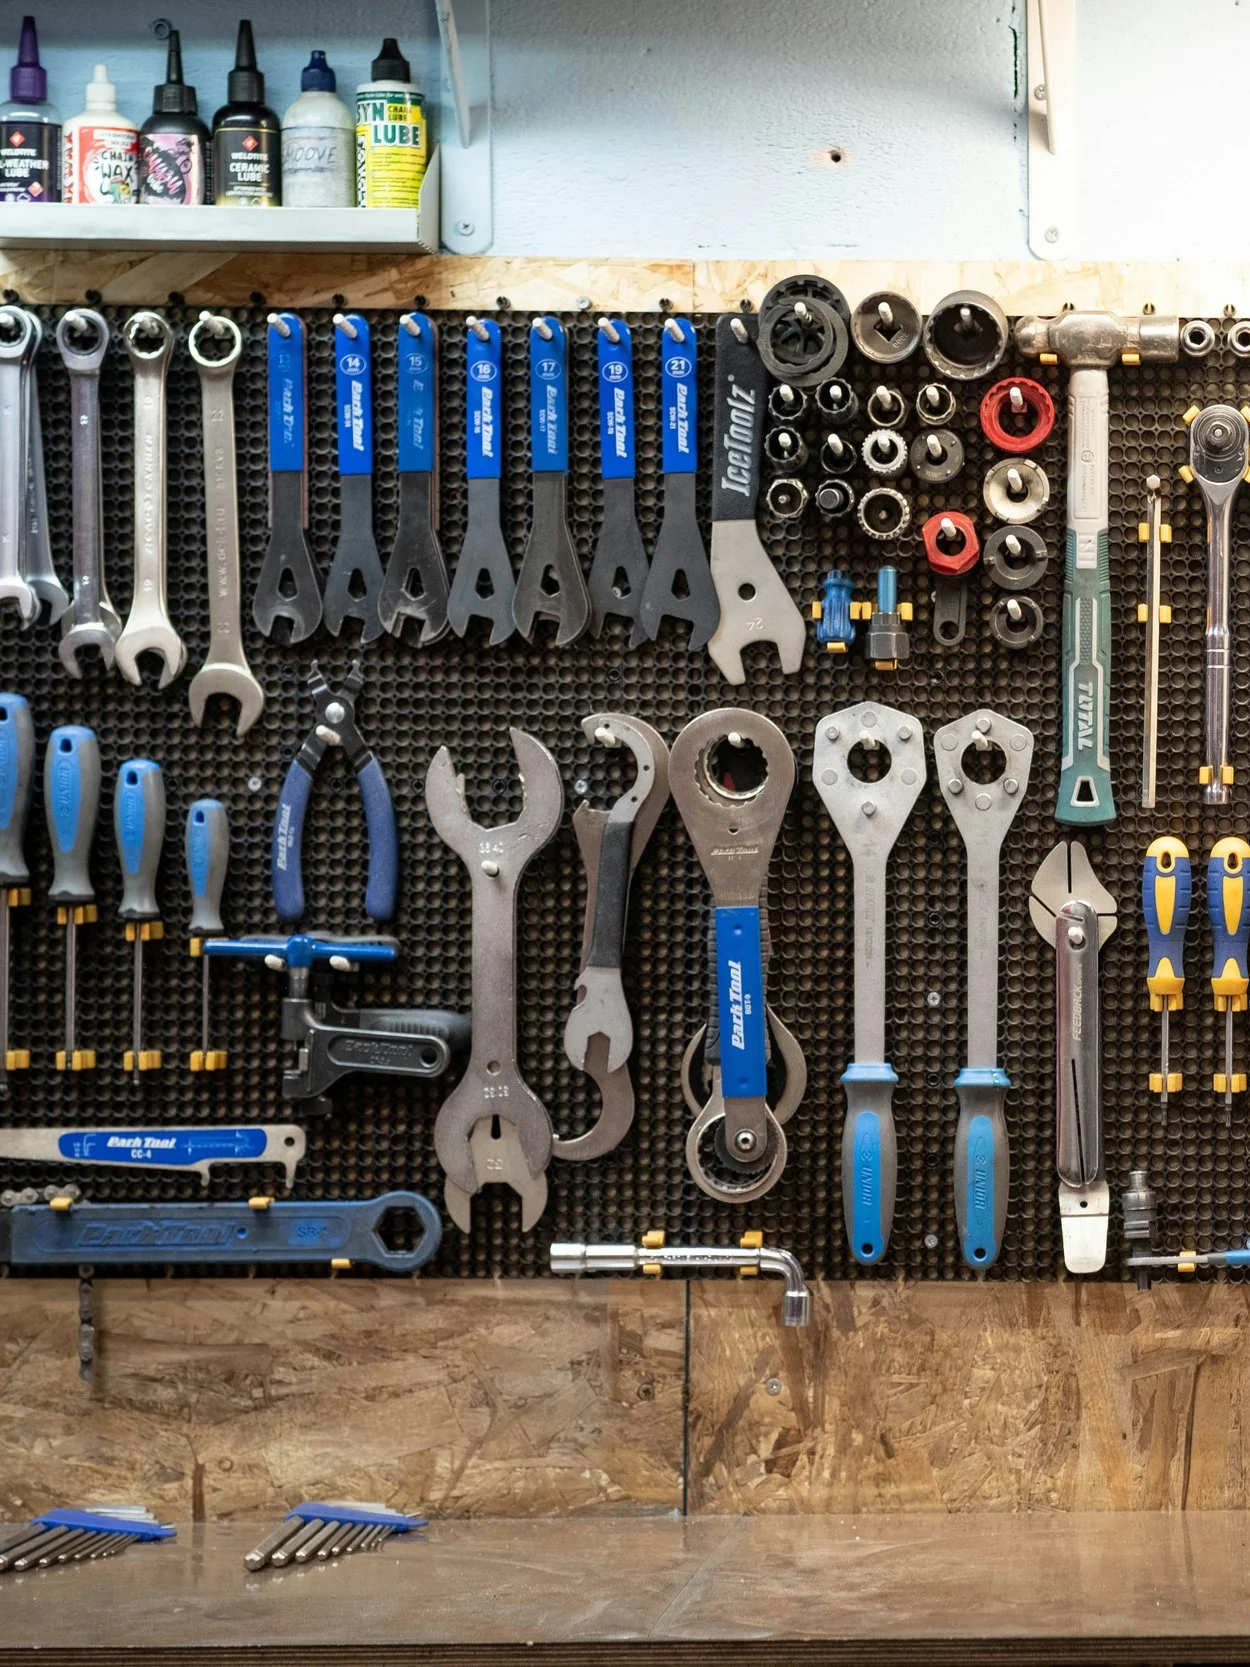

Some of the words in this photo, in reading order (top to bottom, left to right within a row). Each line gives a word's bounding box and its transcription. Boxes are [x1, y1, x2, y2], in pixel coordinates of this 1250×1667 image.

[373, 124, 420, 146] LUBE
[231, 152, 269, 161] WELDTITE
[5, 168, 30, 178] LUBE
[101, 164, 134, 183] WAX
[229, 162, 270, 174] CERAMIC
[237, 172, 264, 182] LUBE
[347, 357, 361, 367] 14
[409, 356, 422, 367] 15
[477, 363, 491, 375] 16
[541, 361, 556, 372] 17
[608, 364, 623, 376] 19
[671, 360, 687, 371] 21
[352, 417, 365, 452] Tool
[482, 423, 494, 457] Tool
[616, 424, 627, 458] Tool
[678, 419, 690, 454] Tool
[721, 384, 755, 497] IceToolz
[1077, 681, 1094, 751] TOTAL
[728, 960, 743, 1005] Tool
[744, 993, 752, 1016] BBT-9
[1071, 984, 1083, 1042] FEEDBACK
[730, 1002, 745, 1050] Park
[107, 1136, 143, 1149] Park
[143, 1136, 177, 1149] Tool
[130, 1148, 153, 1159] CC-4
[861, 1166, 873, 1206] UNIOR
[974, 1168, 987, 1211] UNIOR
